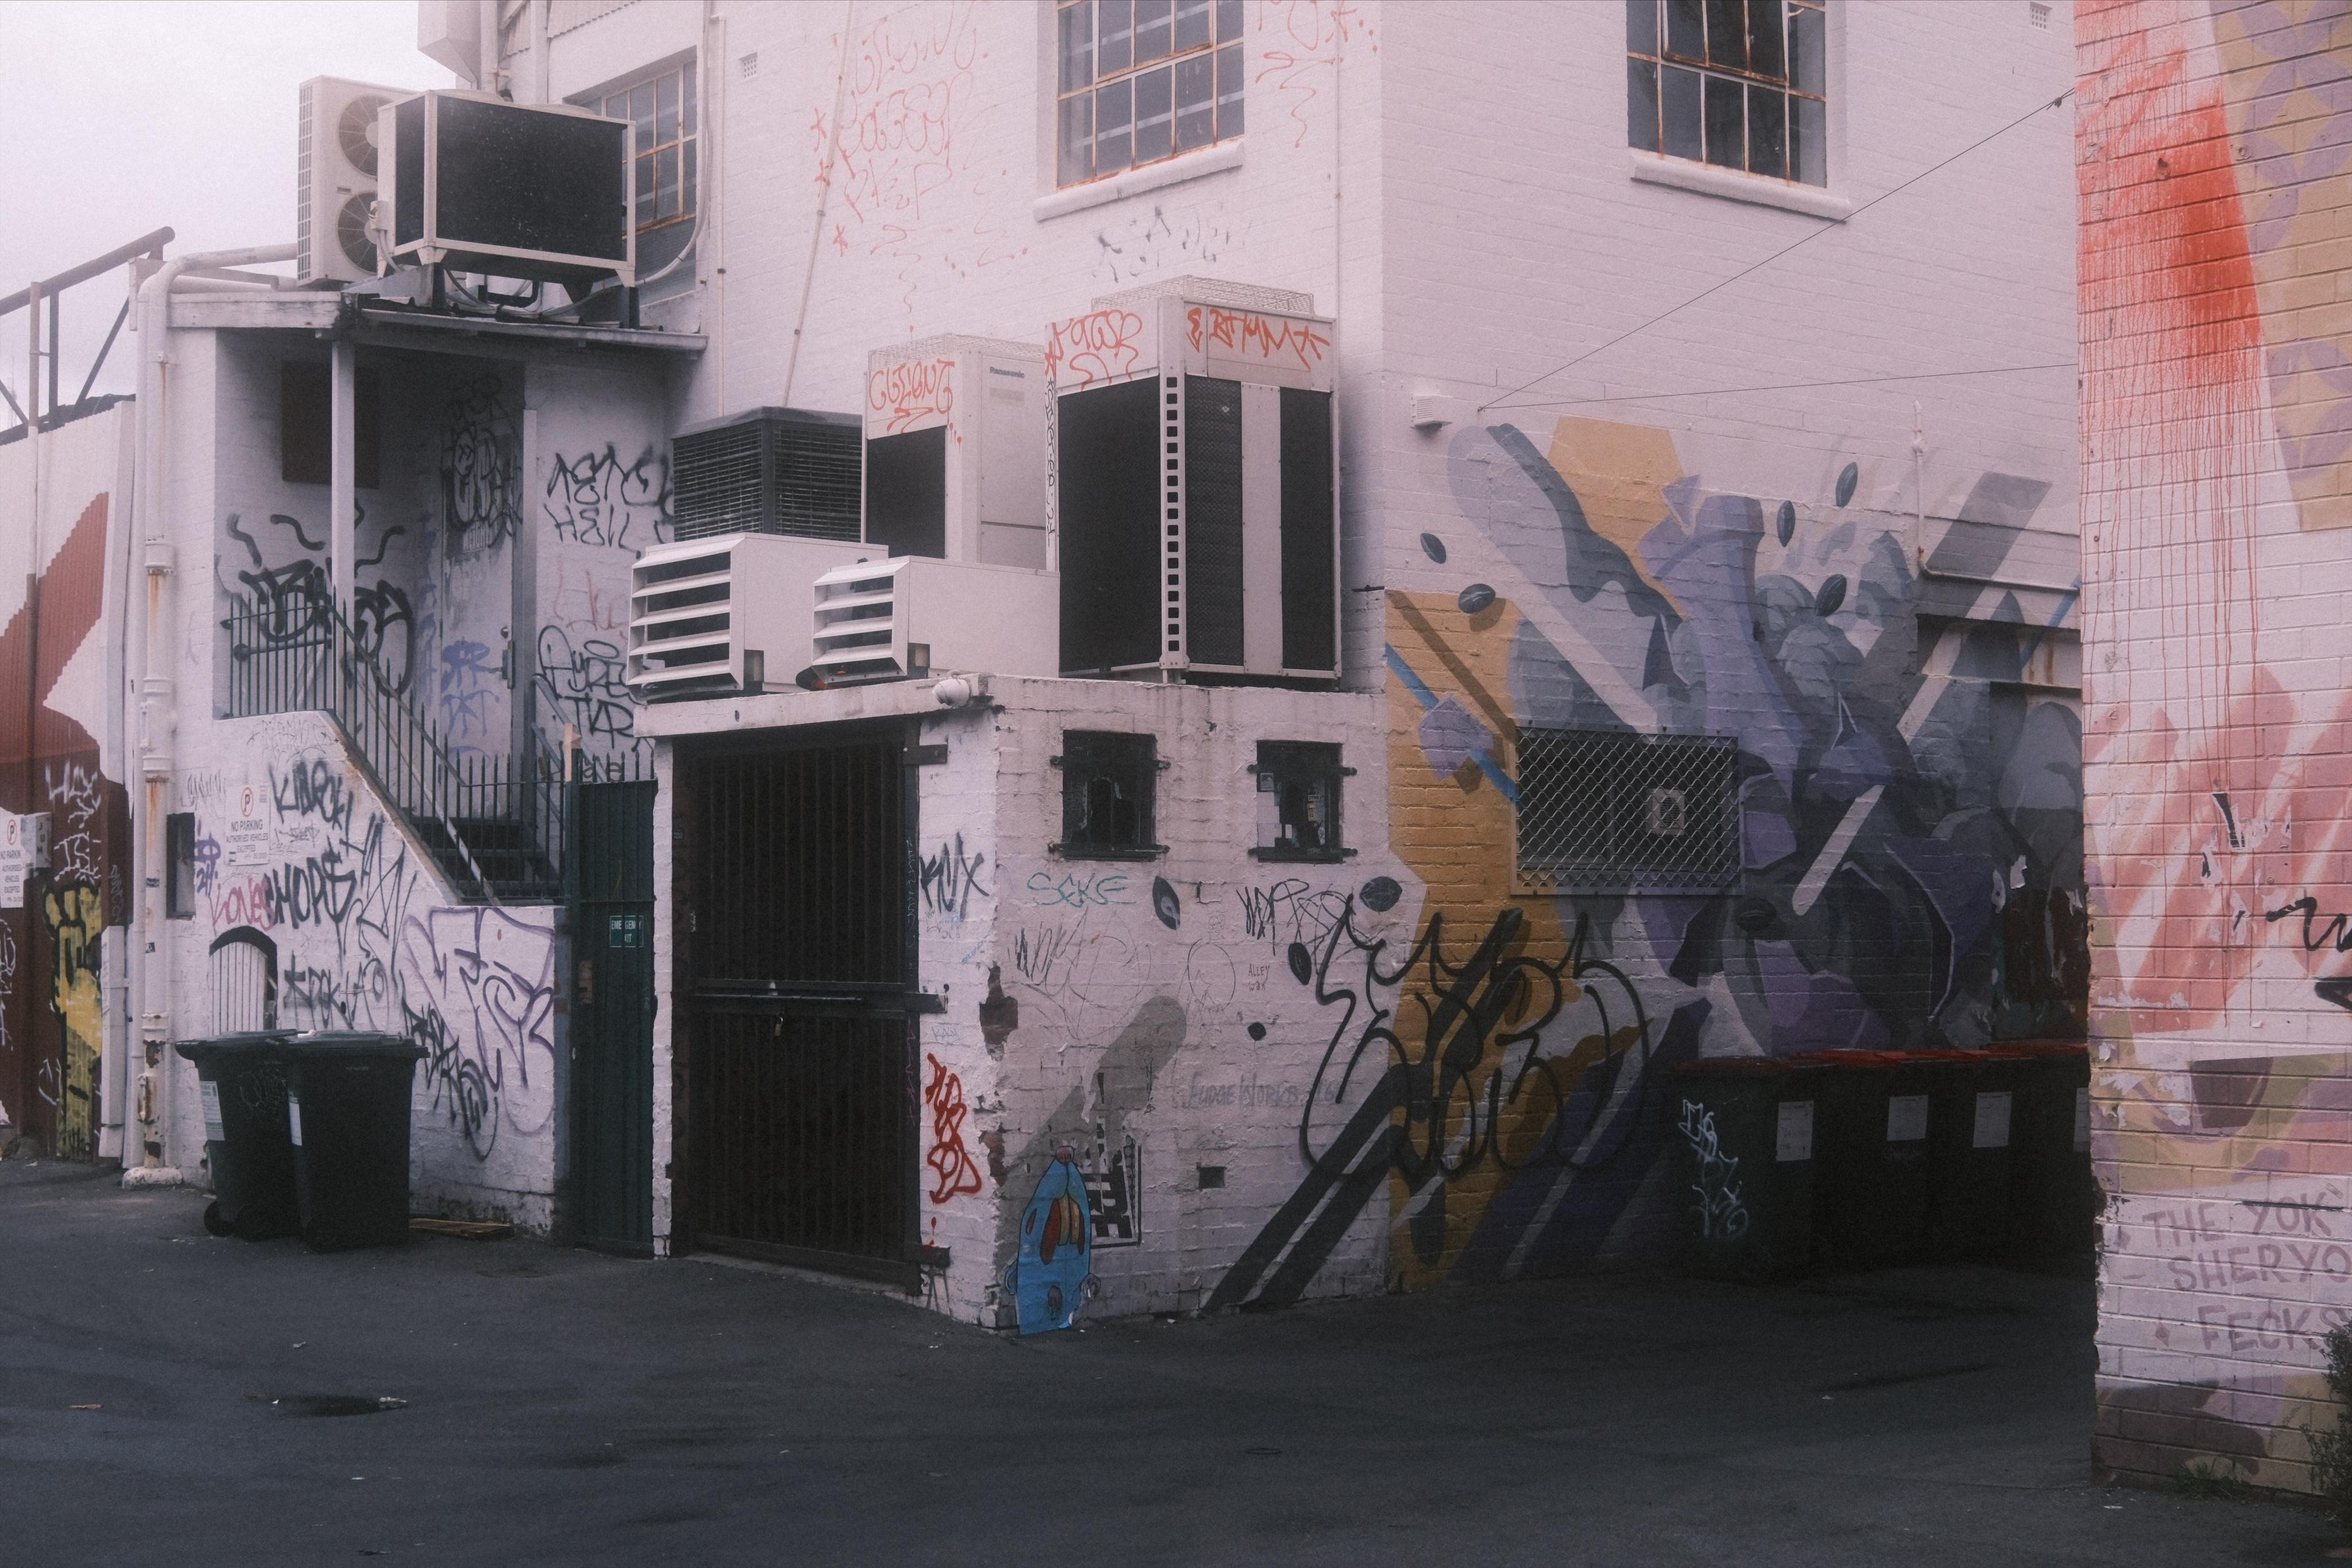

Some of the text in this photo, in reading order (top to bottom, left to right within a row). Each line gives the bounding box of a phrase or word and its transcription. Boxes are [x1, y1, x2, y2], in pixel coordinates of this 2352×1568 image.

[989, 366, 1025, 378] Panasonic
[231, 819, 263, 831] NO PARKING
[250, 833, 269, 841] VEHICLES
[611, 920, 642, 930] EMEGENY
[2142, 1191, 2331, 1248] THE YOK
